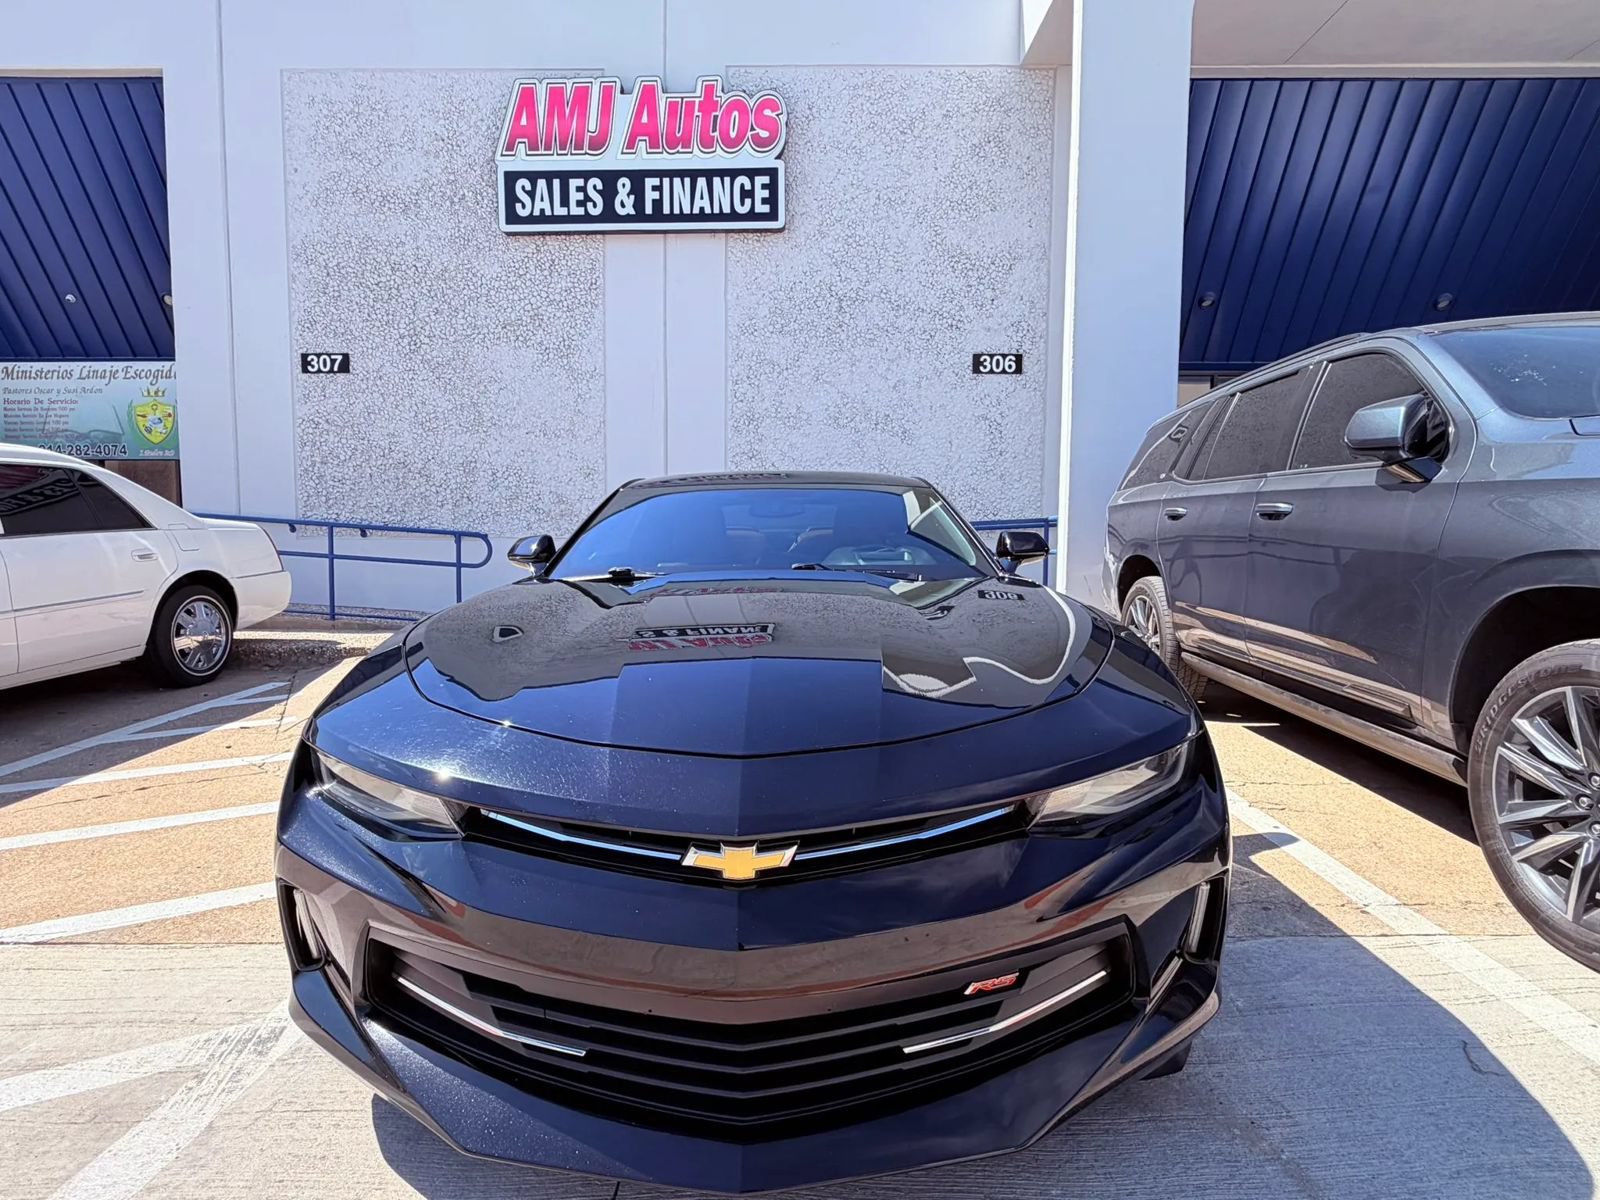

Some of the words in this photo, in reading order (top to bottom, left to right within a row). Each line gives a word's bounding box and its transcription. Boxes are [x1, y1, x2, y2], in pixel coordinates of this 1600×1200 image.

[501, 82, 617, 155] AMJ
[621, 80, 783, 154] Autos
[515, 177, 603, 216] SALES
[614, 176, 636, 215] &
[645, 175, 770, 214] FINANCE
[307, 355, 343, 372] 307
[980, 355, 1016, 373] 306
[1, 364, 74, 381] Ministerios
[77, 365, 119, 386] Linaje
[3, 397, 31, 405] Horario
[39, 445, 127, 457] 14-282-4074
